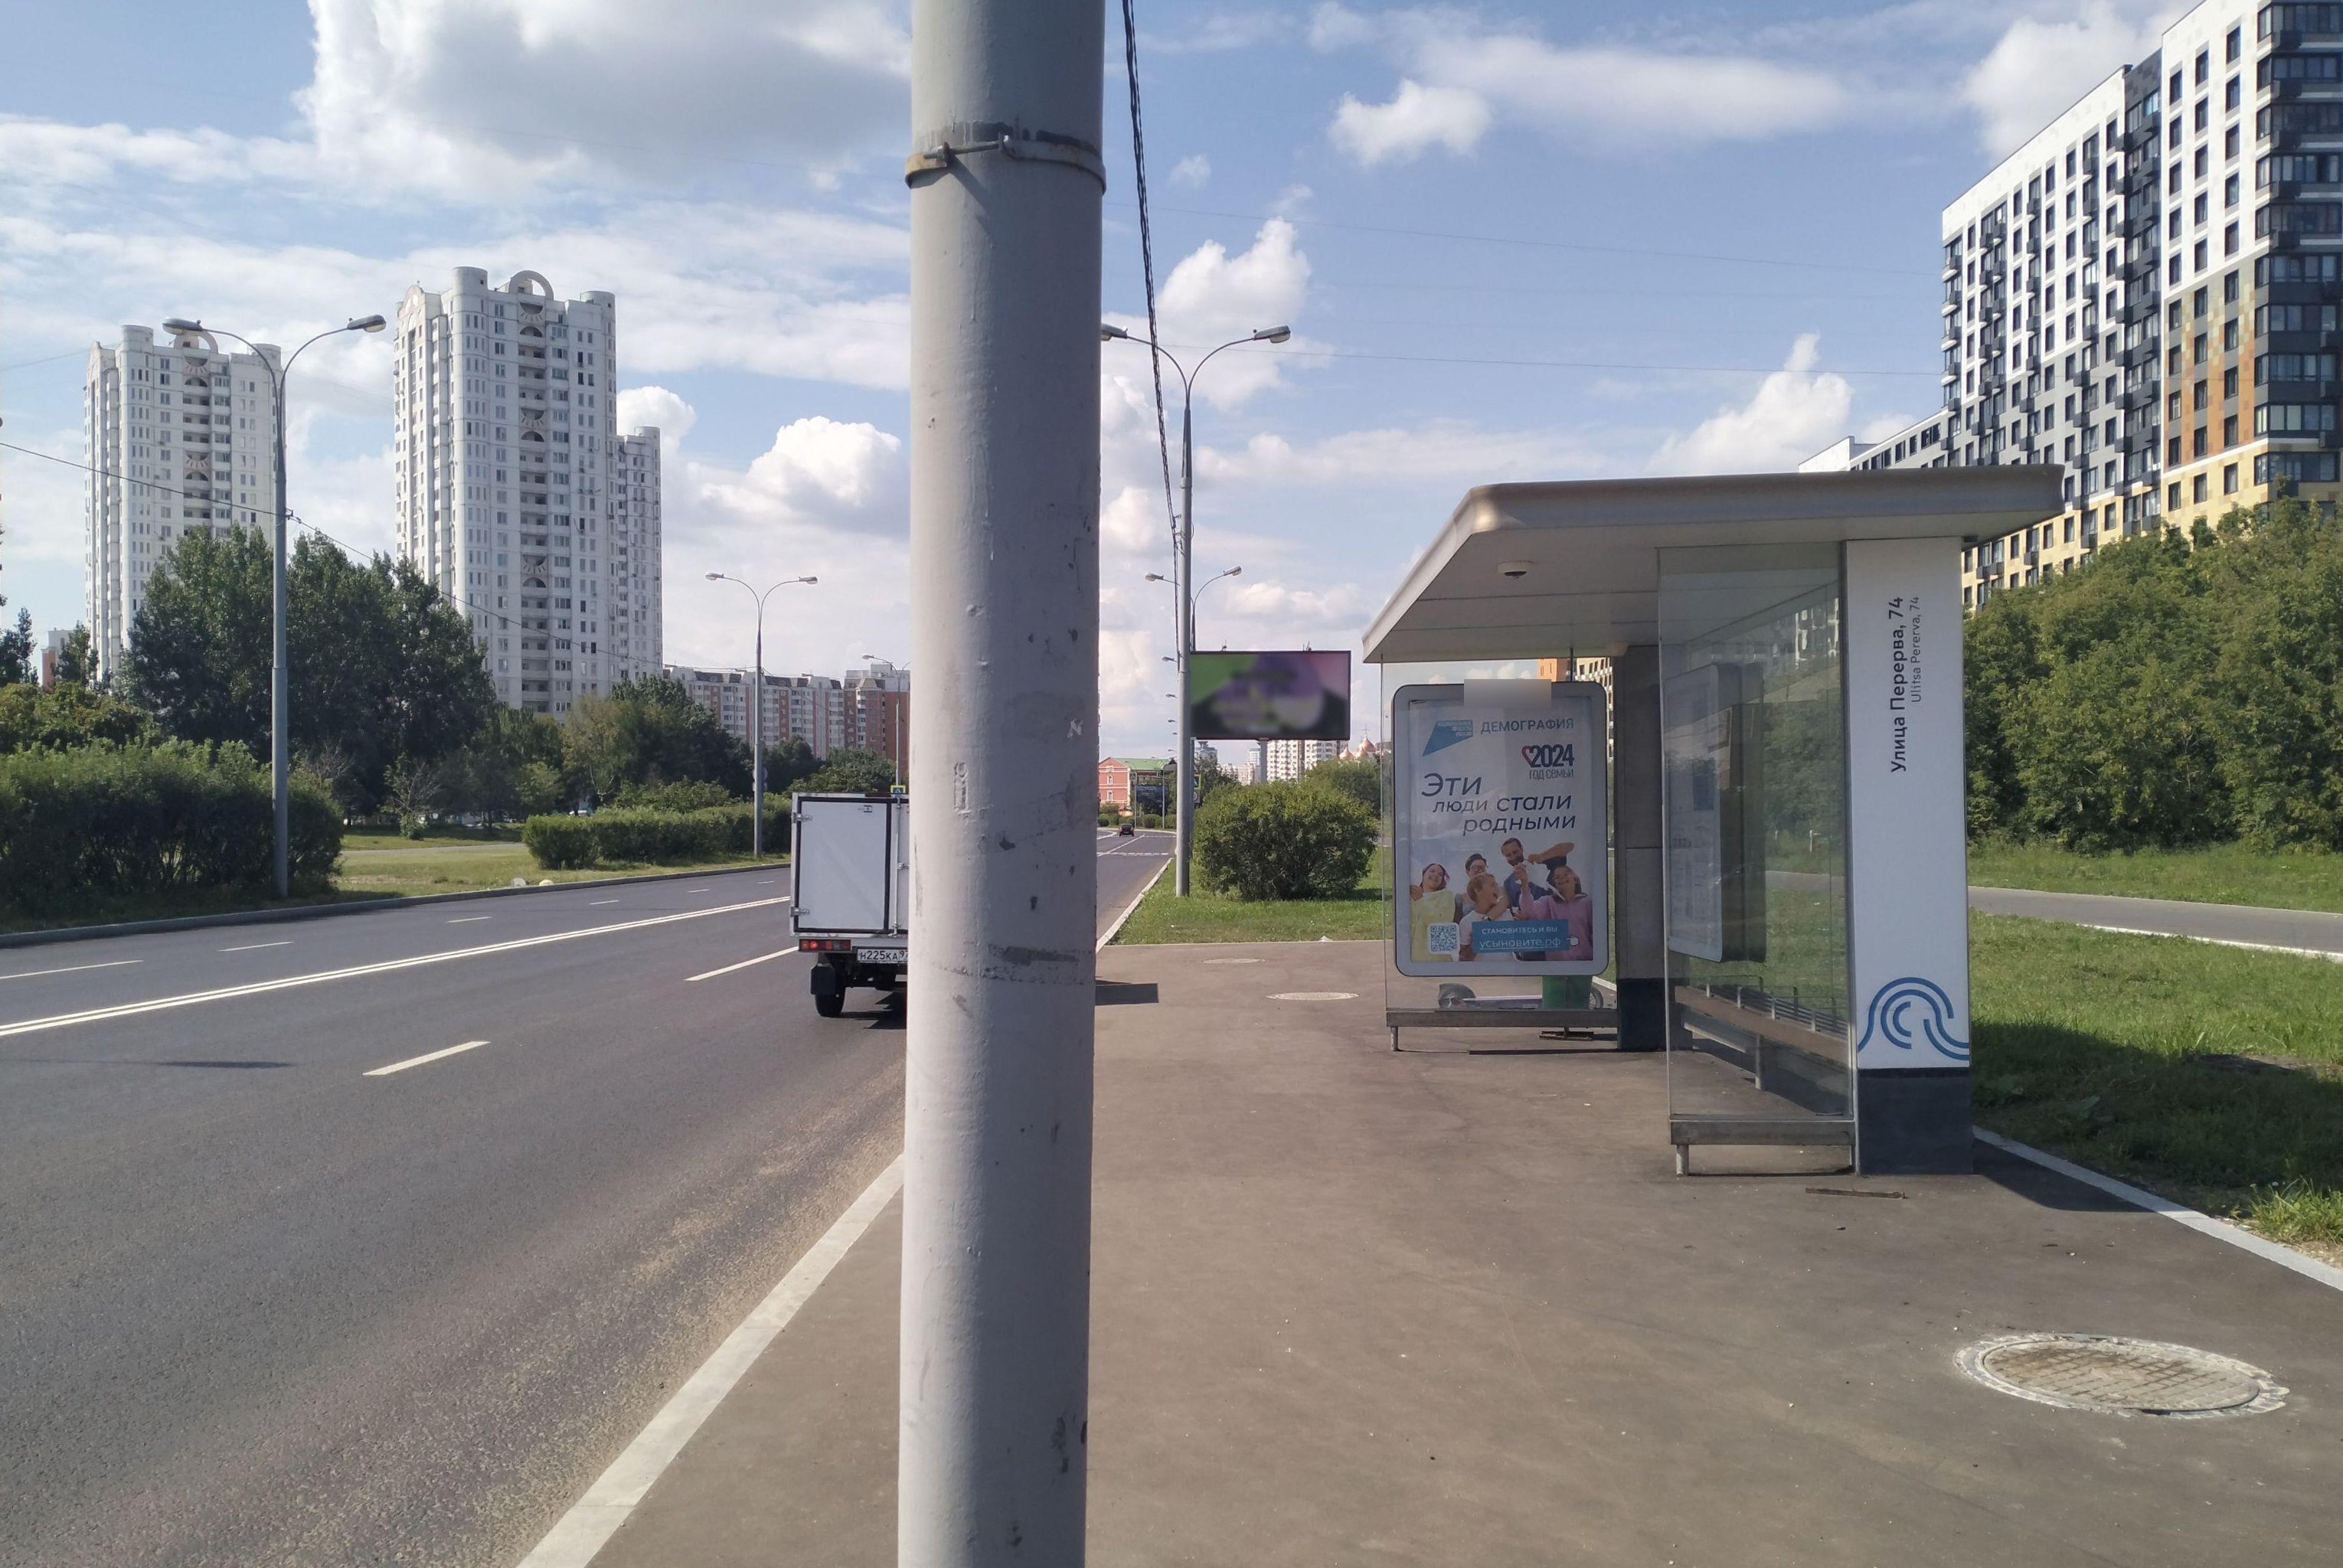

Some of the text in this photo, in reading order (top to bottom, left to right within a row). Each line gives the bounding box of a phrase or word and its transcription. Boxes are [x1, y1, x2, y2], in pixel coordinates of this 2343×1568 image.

[1909, 596, 1922, 703] Ulitsa Pererva, 74
[1888, 596, 1908, 773] Улица Перерва, 74
[1480, 717, 1574, 735] ДЕМОГРАФИЯ
[1529, 743, 1575, 768] 2024
[1421, 773, 1482, 797] Эти
[1432, 795, 1572, 814] люди стали
[1462, 815, 1577, 836] родными
[1479, 936, 1562, 949] усыновите.рф
